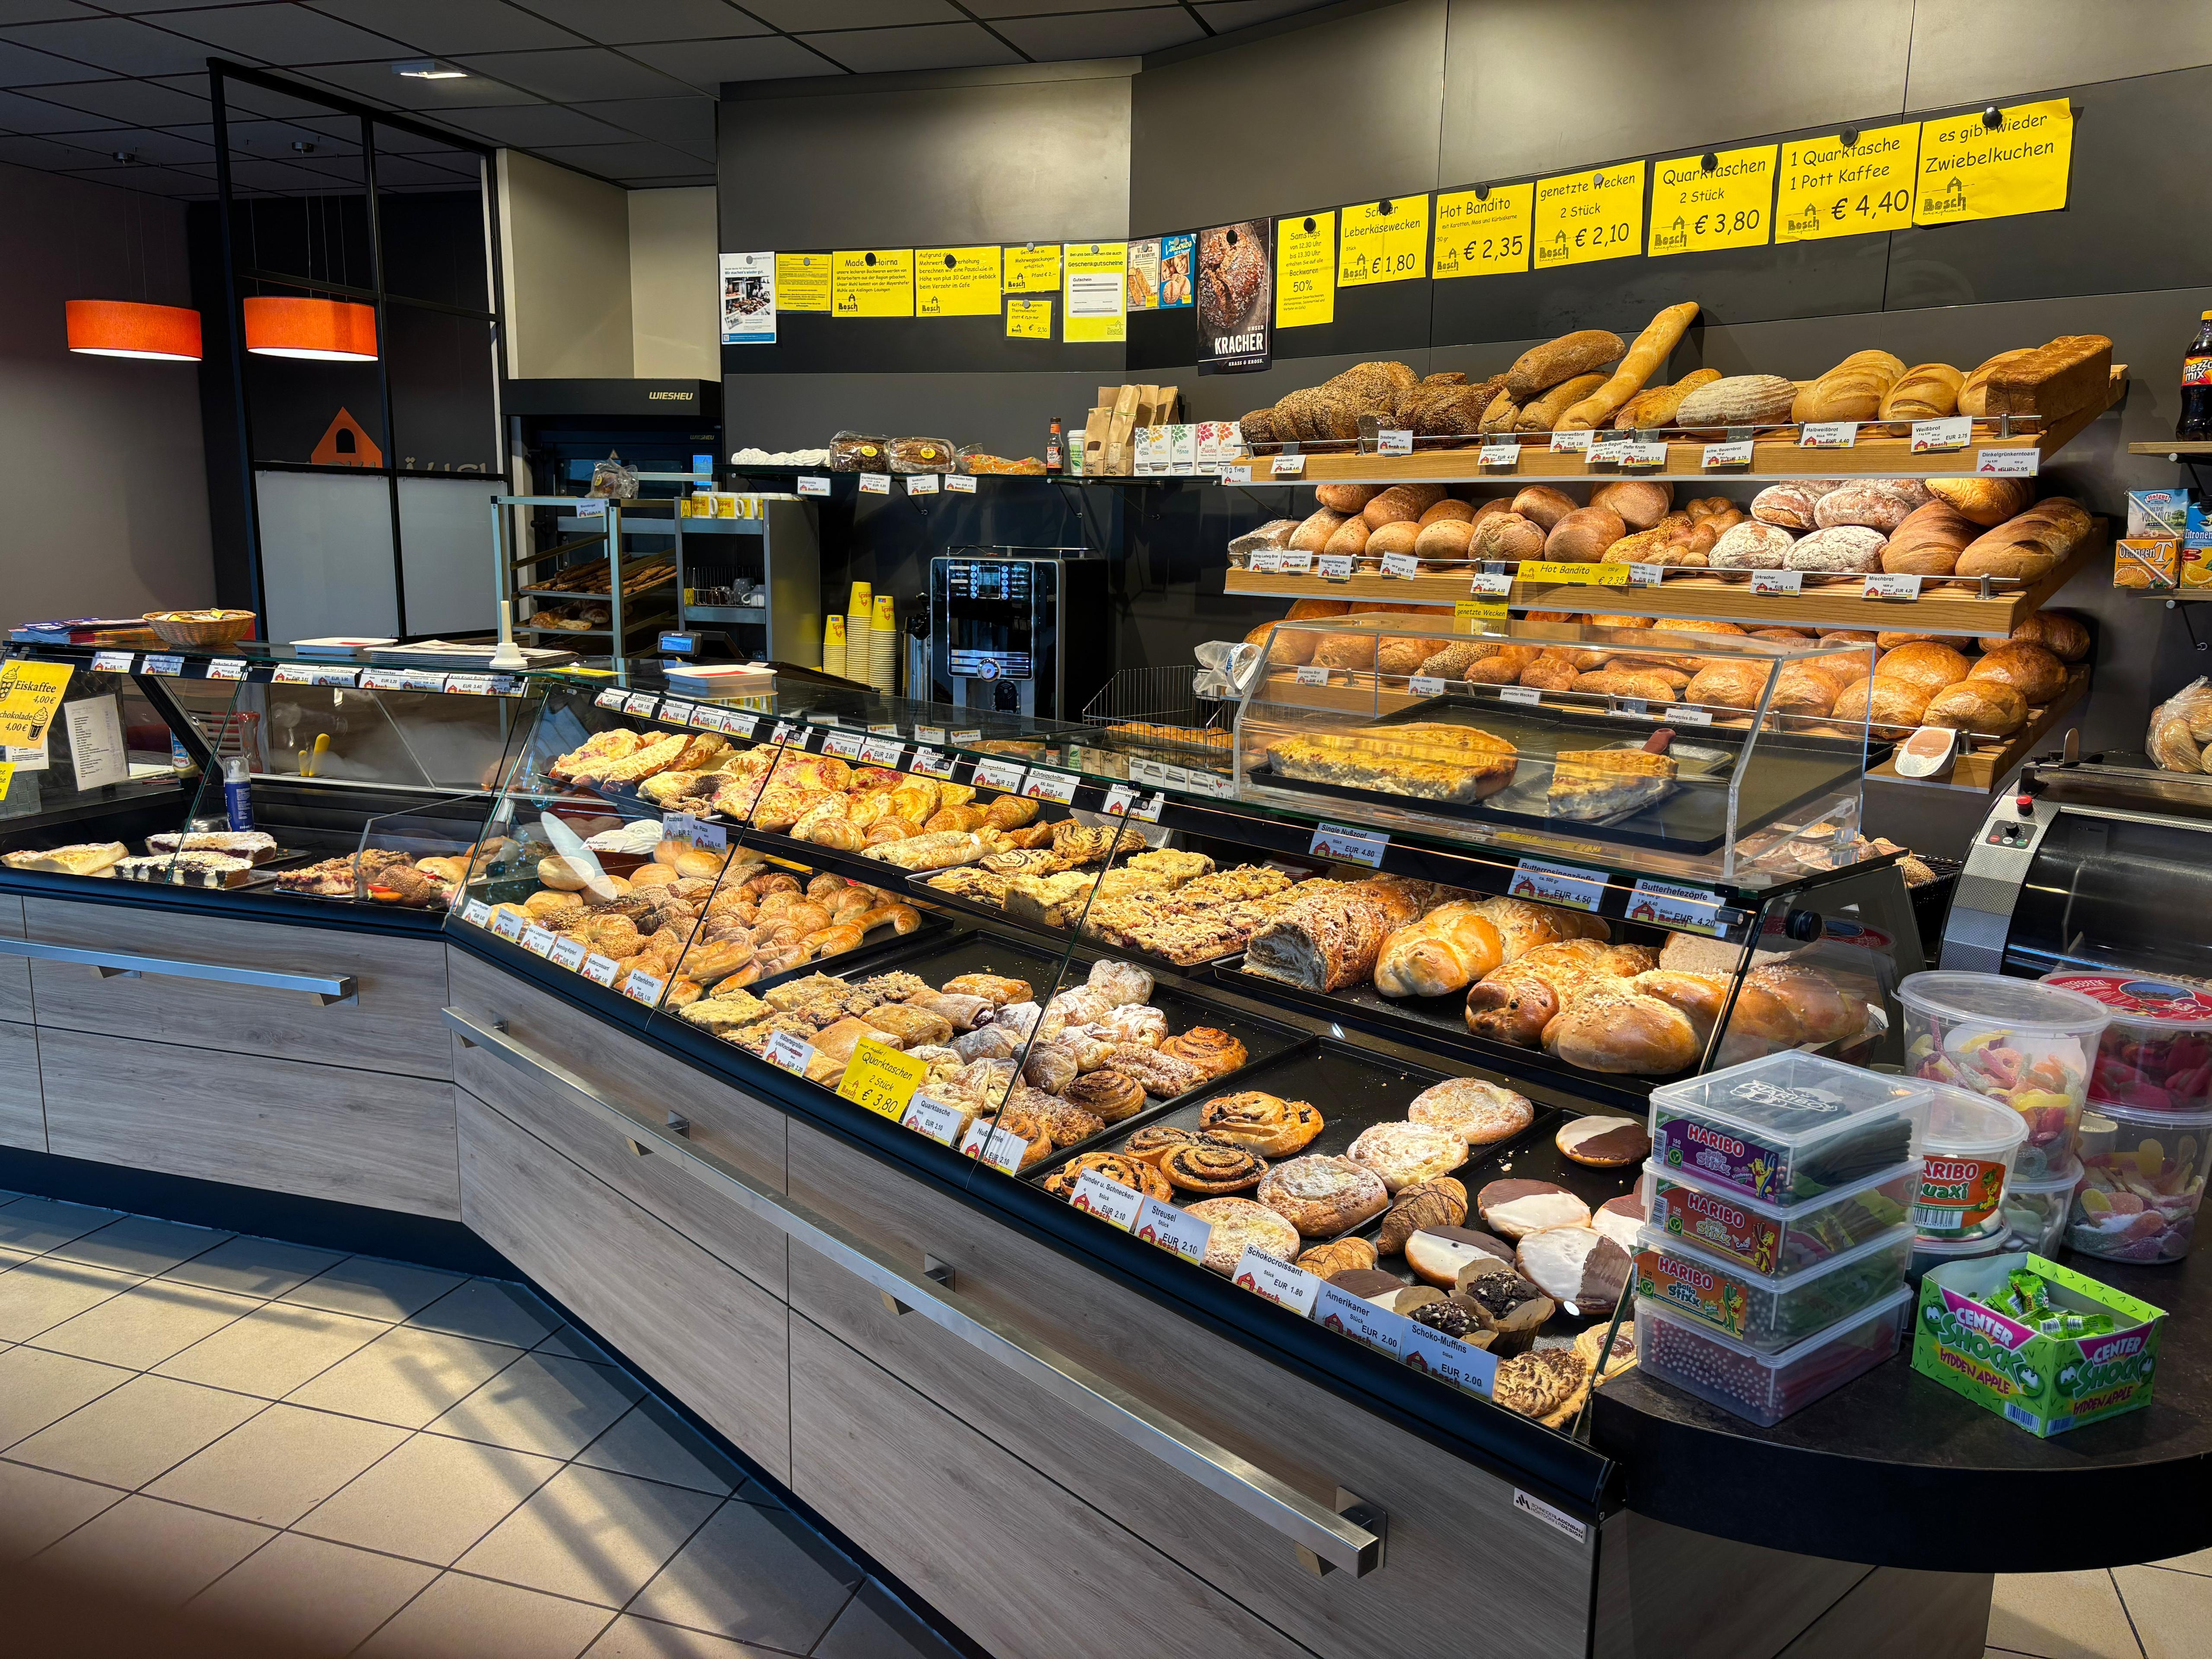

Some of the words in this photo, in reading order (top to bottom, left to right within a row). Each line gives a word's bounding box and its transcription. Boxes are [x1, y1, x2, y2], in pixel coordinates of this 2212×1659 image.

[1939, 131, 1955, 142] es
[1960, 124, 1988, 143] gibt
[1996, 114, 2047, 133] wieder
[1791, 152, 1797, 166] 1
[1804, 138, 1900, 166] Quarktasche
[1926, 142, 2053, 173] Zwiebelkuchen
[1663, 159, 1766, 186] Quarktaschen
[1790, 177, 1796, 190] 1
[1802, 172, 1833, 189] Pott
[1839, 164, 1889, 184] Kaffee
[1541, 182, 1588, 201] genetzte
[1594, 175, 1635, 190] Wecken
[1680, 193, 1687, 203] 2
[1691, 188, 1725, 202] Stück
[1440, 205, 1462, 219] Hot
[1466, 198, 1510, 215] Bandito
[1560, 208, 1567, 218] 2
[1570, 204, 1601, 217] Stück
[1831, 197, 1848, 220] €
[1856, 189, 1909, 219] 4,40
[1923, 193, 1966, 212] Bosch
[1345, 219, 1420, 238] Leberkäsewecken
[1694, 215, 1708, 235] €
[1715, 209, 1760, 235] 3,80
[1788, 216, 1819, 231] Bosch
[1290, 231, 1320, 240] Samstags
[1575, 229, 1587, 248] €
[1592, 223, 1629, 248] 2,10
[1655, 231, 1687, 247] Bosch
[1464, 240, 1476, 260] €
[1483, 235, 1522, 261] 2,35
[1372, 257, 1381, 273] €
[1386, 253, 1415, 275] 1,80
[1293, 280, 1313, 292] 50%
[1214, 333, 1263, 355] KRACHER
[2184, 359, 2212, 374] mezzo
[2185, 367, 2207, 381] mix
[649, 391, 693, 400] WIESHEU
[2154, 541, 2173, 562] T
[1541, 565, 1557, 573] Hot
[1560, 566, 1590, 575] Bandito
[1608, 576, 1624, 585] 2,35
[14, 680, 56, 693] Eiskaffee
[33, 696, 49, 704] 4,00
[0, 710, 32, 721] chokolade
[5, 723, 22, 731] 4,00
[1033, 770, 1065, 781] Rührteigschnitten
[1322, 825, 1340, 833] Single
[1345, 845, 1359, 854] EUR
[1575, 894, 1592, 904] 4.50
[1641, 882, 1708, 901] Butterhefezöpfe
[1697, 916, 1716, 927] 4.20
[633, 973, 654, 987] Butterhörnle
[862, 1052, 913, 1081] Quarktaschen
[875, 1078, 894, 1091] Stück
[861, 1089, 873, 1101] €
[873, 1094, 898, 1113] 3,80
[921, 1100, 950, 1117] Quarktasche
[925, 1119, 934, 1128] EUR
[1687, 1123, 1744, 1157] HARIBO
[989, 1152, 999, 1161] EUR
[1000, 1157, 1009, 1165] 2.10
[1696, 1152, 1731, 1176] Stixx
[1705, 1148, 1726, 1163] Balla
[1923, 1160, 1978, 1180] ARIBO
[1081, 1173, 1100, 1185] Plunder
[1106, 1184, 1134, 1200] Schnecken
[1922, 1182, 1969, 1200] uaxi
[1102, 1205, 1113, 1215] EUR
[1115, 1211, 1125, 1220] 2.10
[1152, 1205, 1176, 1222] Streusel
[1688, 1192, 1745, 1229] HARIBO
[1158, 1220, 1169, 1228] Stück
[1696, 1221, 1731, 1246] Stixx
[1706, 1218, 1727, 1233] Balla
[1163, 1233, 1179, 1247] EUR
[1182, 1241, 1197, 1255] 2.10
[1248, 1246, 1303, 1277] Schokocroissant
[1264, 1270, 1274, 1278] Stück
[1658, 1256, 1713, 1290] HARIBO
[1274, 1278, 1287, 1291] EUR
[1291, 1286, 1303, 1297] 1.80
[1668, 1284, 1700, 1308] Stixx
[1676, 1281, 1696, 1295] Balla
[1325, 1290, 1370, 1317] Amerikaner
[1350, 1314, 1363, 1324] Stück
[1955, 1308, 2013, 1346] CENTER
[1362, 1324, 1378, 1339] EUR
[1382, 1335, 1397, 1347] 2.00
[1412, 1324, 1467, 1354] Schoko-Muffins
[1939, 1312, 2024, 1387] SHOCK
[2093, 1337, 2142, 1363] CENTER
[1441, 1363, 1459, 1378] EUR
[1464, 1373, 1482, 1387] 2.00
[1939, 1347, 1976, 1377] HIDDEN
[1976, 1370, 2011, 1395] APPLE
[2074, 1350, 2149, 1399] SHOCK
[2074, 1396, 2105, 1415] HIDDEN
[2103, 1386, 2133, 1408] APPLE
